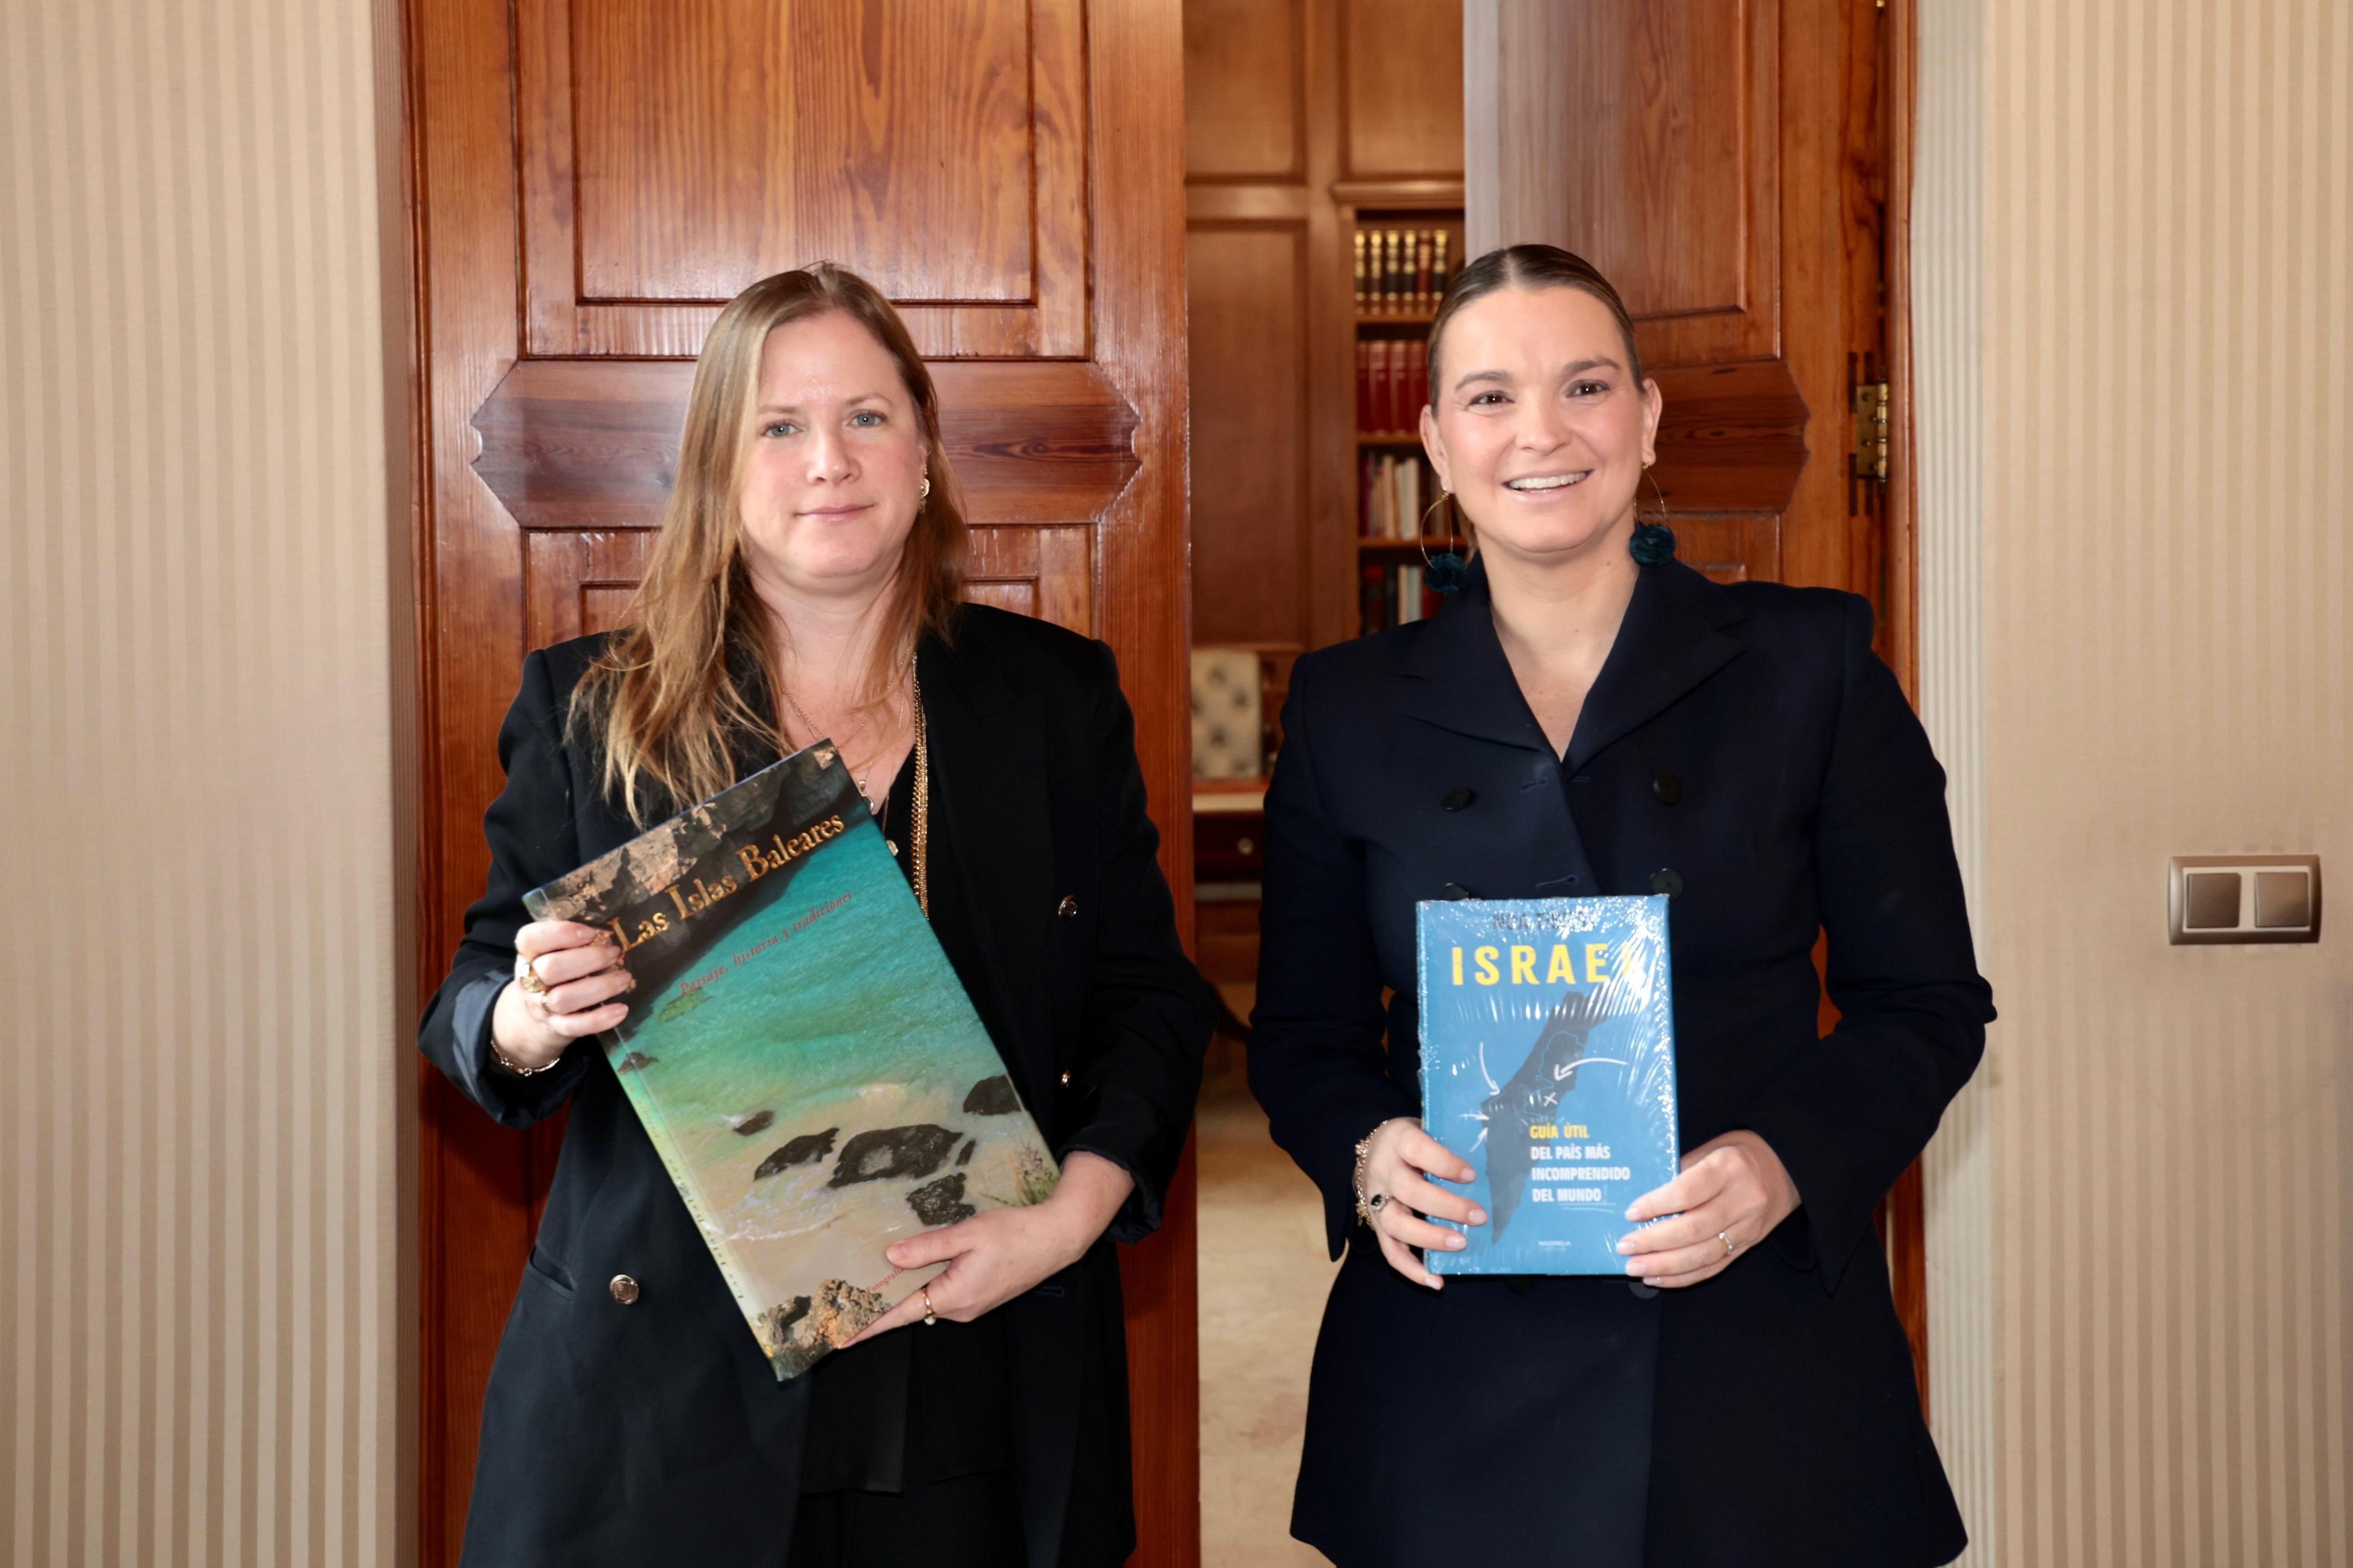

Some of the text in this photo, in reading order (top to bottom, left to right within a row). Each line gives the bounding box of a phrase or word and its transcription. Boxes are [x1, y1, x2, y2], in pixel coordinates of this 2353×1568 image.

[607, 814, 845, 952] Las Islas Baleares
[679, 891, 852, 997] Paisaje, historia y tradiciones
[1452, 943, 1642, 986] ISRAE
[1530, 1123, 1590, 1139] GUÍA ÚTIL
[1531, 1143, 1610, 1160] DEL PAÍS MÁS
[1532, 1167, 1630, 1181] INCOMPRENDIDO
[1532, 1188, 1601, 1202] DEL MUNDO
